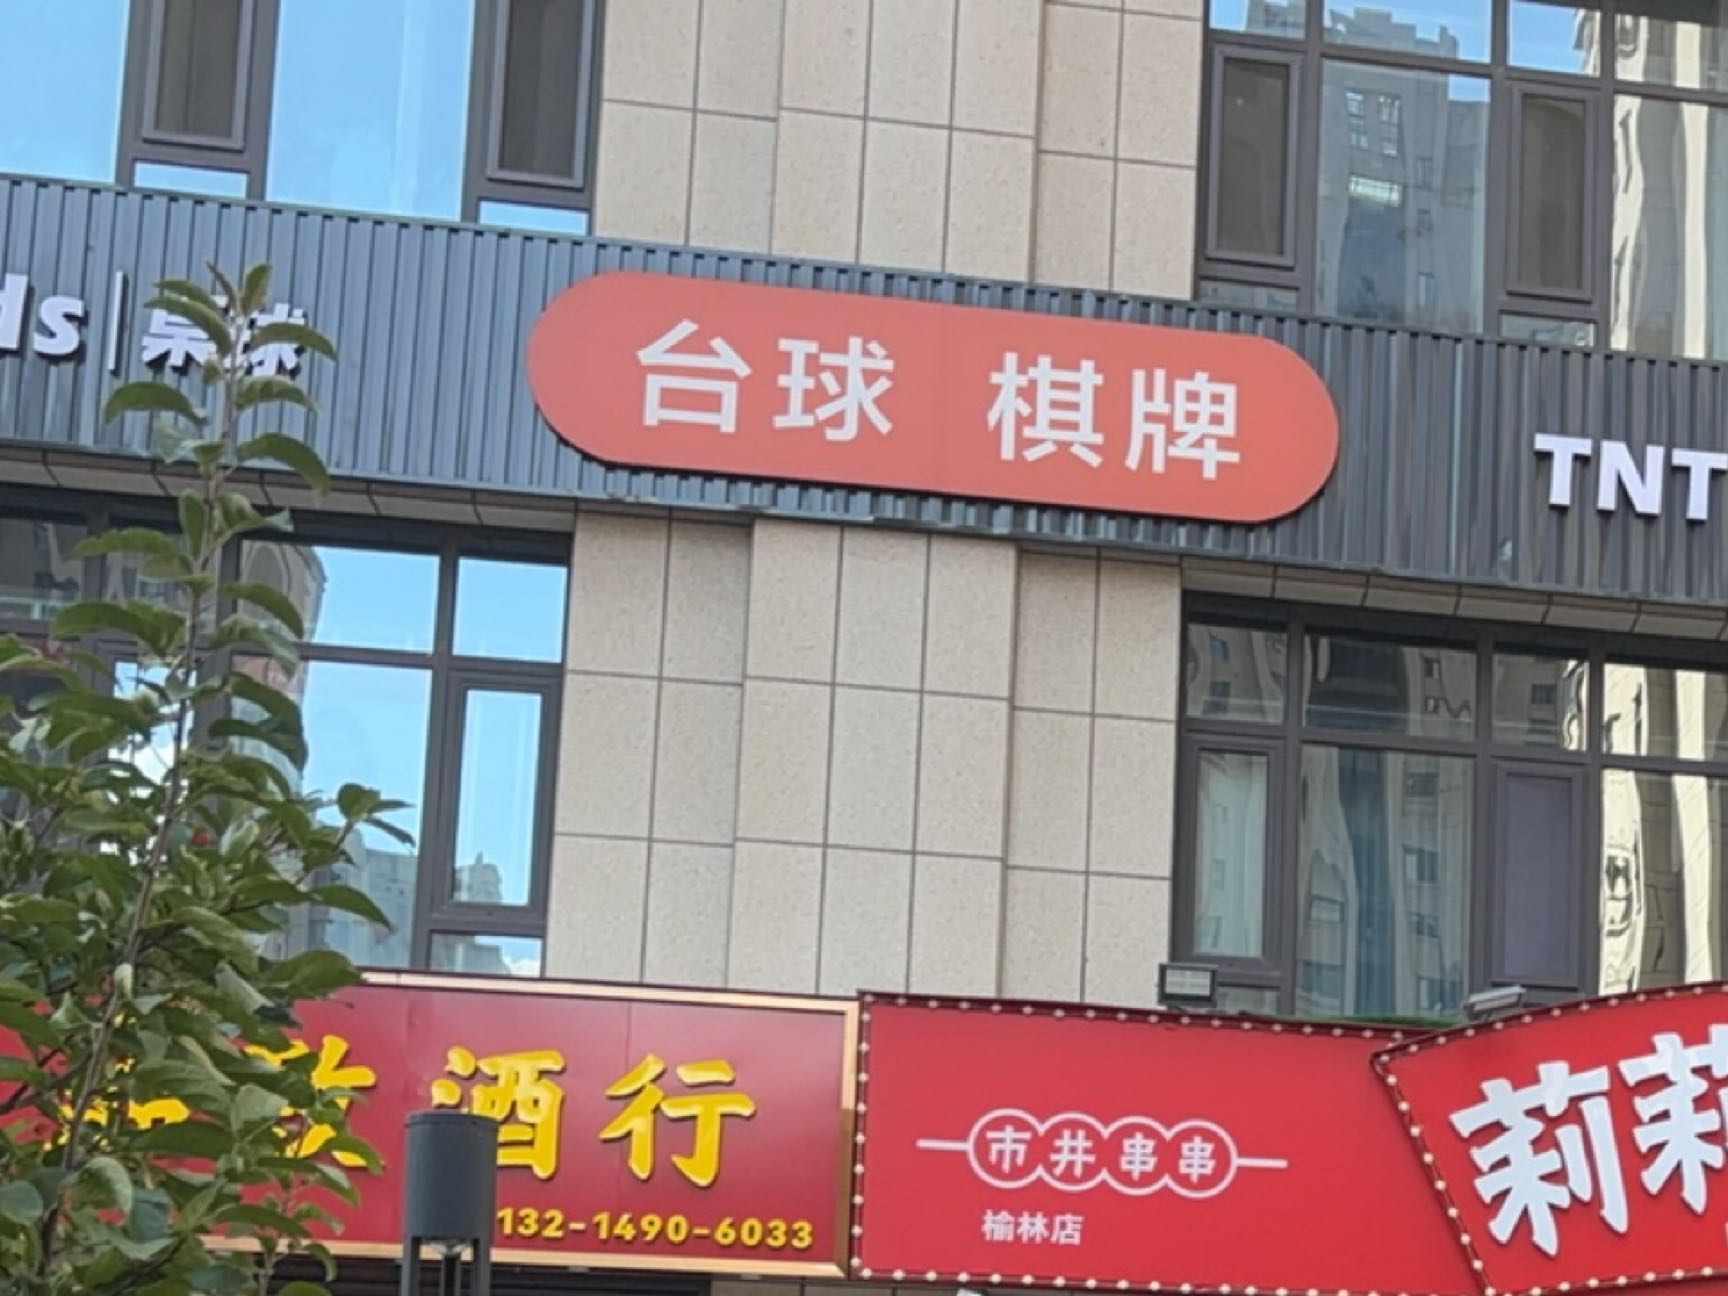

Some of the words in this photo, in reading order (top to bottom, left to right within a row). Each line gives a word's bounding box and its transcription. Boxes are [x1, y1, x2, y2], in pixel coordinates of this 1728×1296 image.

[636, 318, 895, 442] 台球
[986, 351, 1241, 480] 棋牌
[1534, 433, 1728, 521] TNT
[985, 1124, 1217, 1184] 市井串串
[495, 1206, 814, 1249] 132-1490-6033
[981, 1208, 1084, 1246] 榆林店
